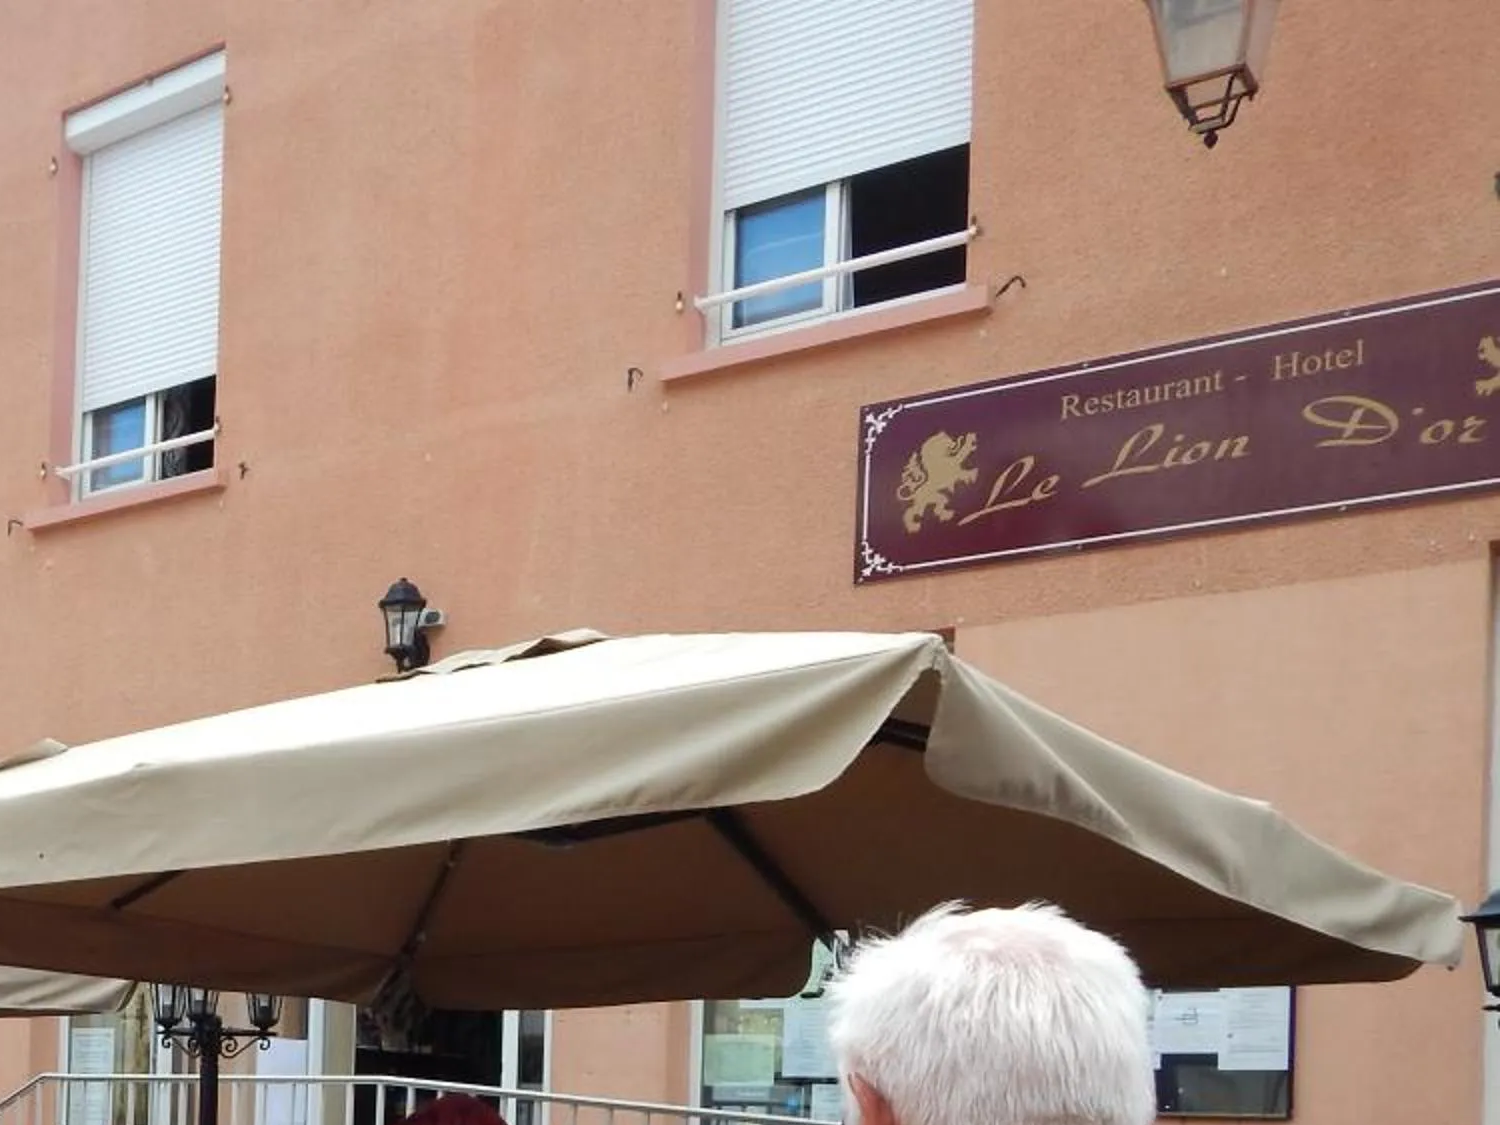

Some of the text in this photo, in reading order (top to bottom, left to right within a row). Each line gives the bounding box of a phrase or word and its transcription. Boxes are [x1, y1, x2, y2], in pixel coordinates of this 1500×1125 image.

[1060, 369, 1226, 421] Restaurant
[1273, 340, 1365, 382] Hotel
[957, 394, 1488, 527] Le Lion D'or
